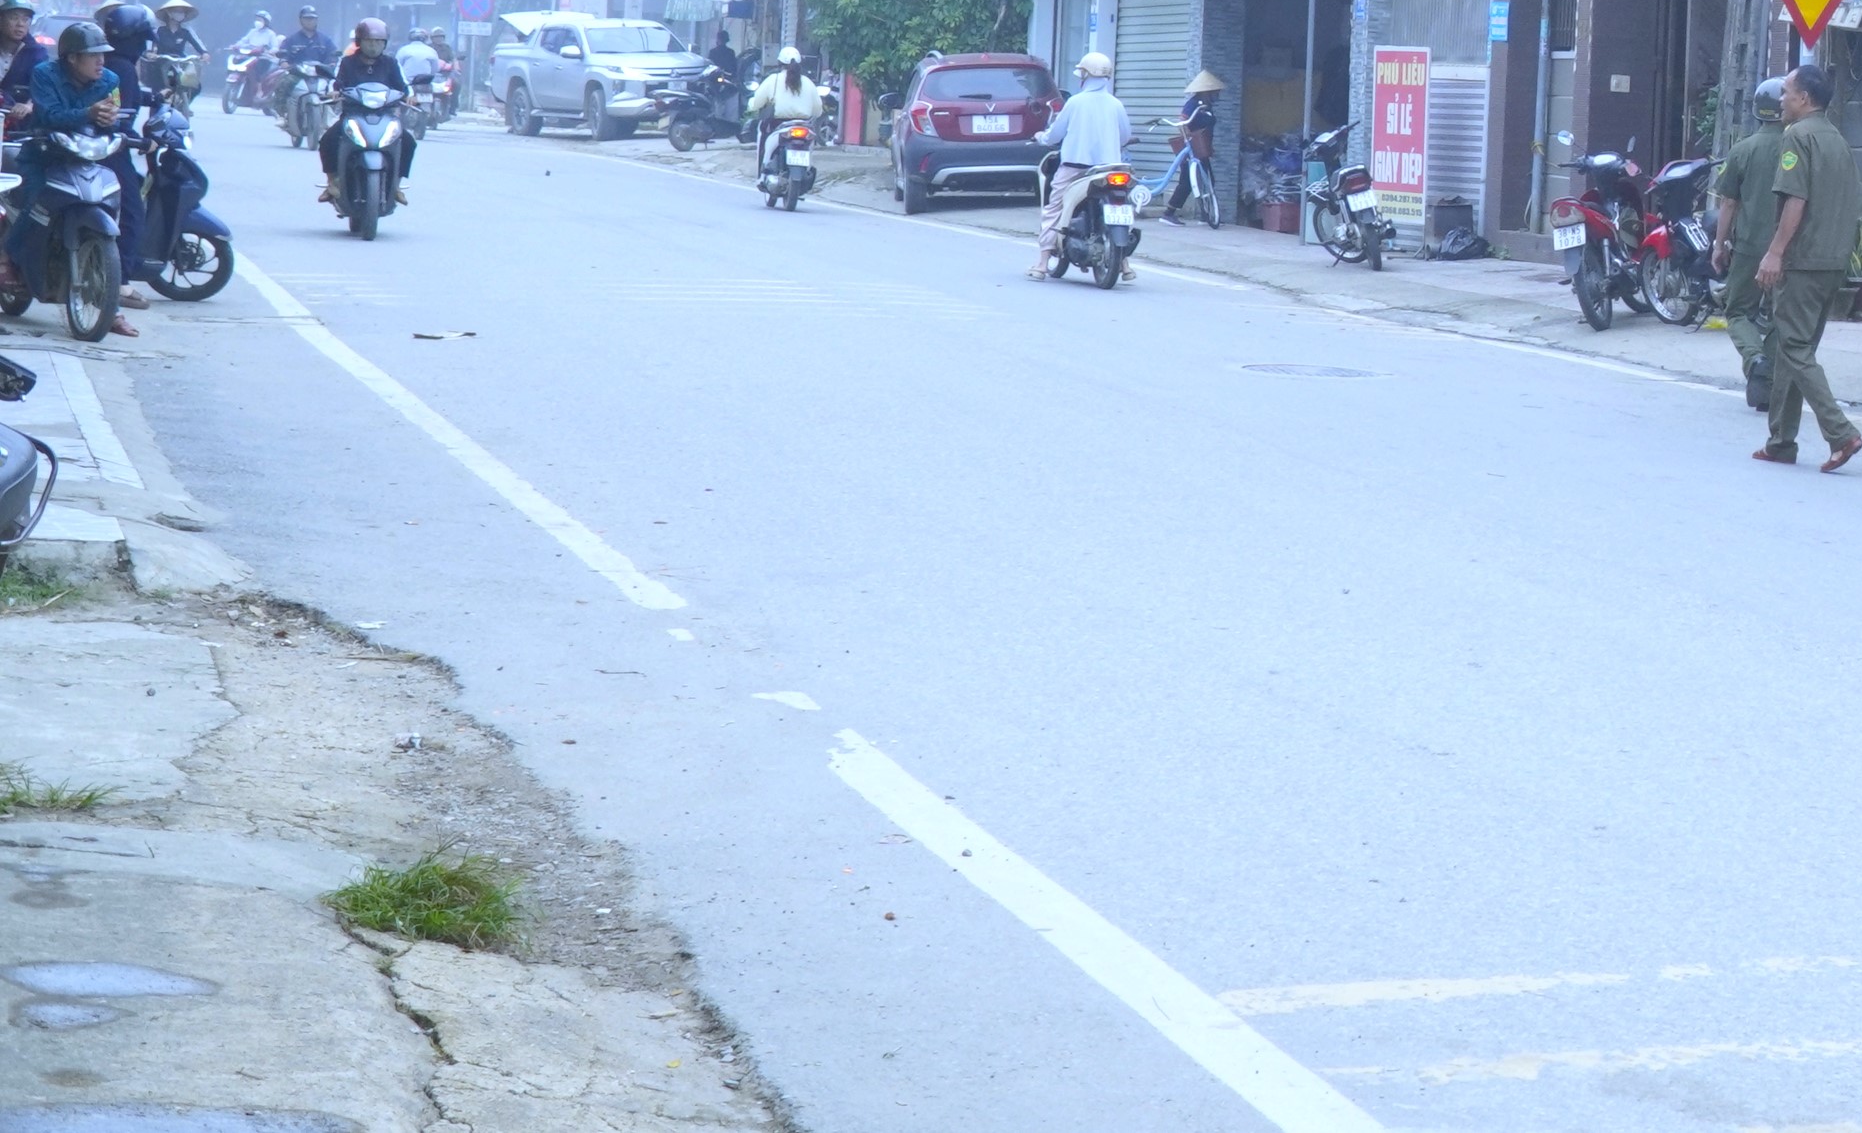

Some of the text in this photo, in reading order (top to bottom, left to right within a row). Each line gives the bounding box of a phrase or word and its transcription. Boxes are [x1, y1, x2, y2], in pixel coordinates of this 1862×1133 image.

[1386, 93, 1413, 135] SỈ LẺ
[1374, 146, 1423, 185] GIÀY DÉP
